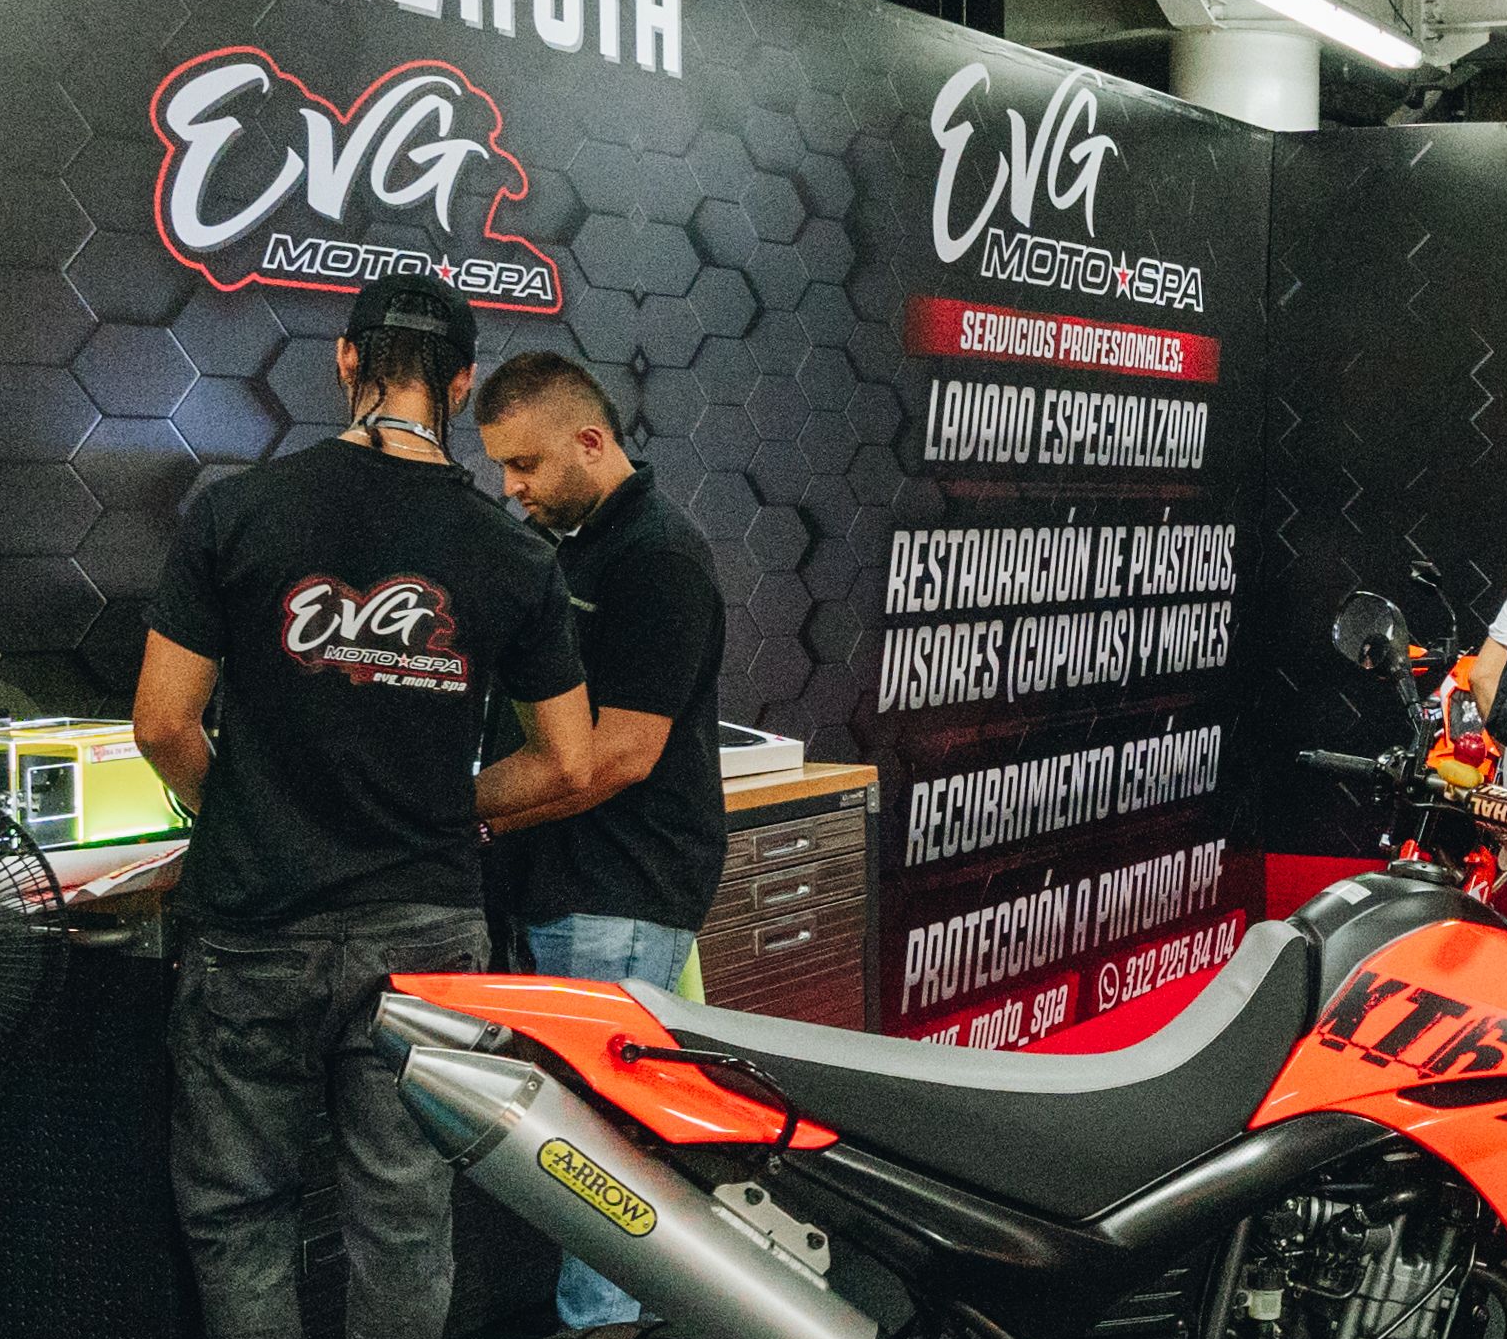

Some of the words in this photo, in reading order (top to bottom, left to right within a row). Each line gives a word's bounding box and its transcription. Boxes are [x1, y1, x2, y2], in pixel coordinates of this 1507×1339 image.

[960, 309, 1056, 360] SERVICIOS
[1058, 314, 1184, 374] PROFESIONALES:
[924, 378, 1037, 463] LAVADO
[1038, 389, 1209, 470] ESPECIALIZADO
[885, 507, 1094, 615] RESTAURACIÓN
[1095, 527, 1128, 600] DE
[1128, 507, 1238, 597] PLÁSTICOS,
[372, 671, 468, 693] evg_moto_spa
[877, 618, 1003, 715] VISORES
[1006, 606, 1136, 704] (CUPULAS)
[1139, 605, 1156, 678] Y
[1156, 600, 1233, 675] MOFLES
[905, 743, 1115, 867] RECUBRIMIENTO
[1116, 715, 1223, 814] CERÁMICO
[900, 869, 1072, 1015] PROTECCIÓN
[1072, 877, 1092, 955] A
[1094, 852, 1185, 948] PINTURA
[1188, 838, 1227, 911] PPF
[1121, 947, 1156, 1003] 312
[1156, 936, 1190, 990] 225
[1189, 928, 1213, 975] 84
[1213, 918, 1238, 965] 04
[551, 1149, 651, 1223] ARROW
